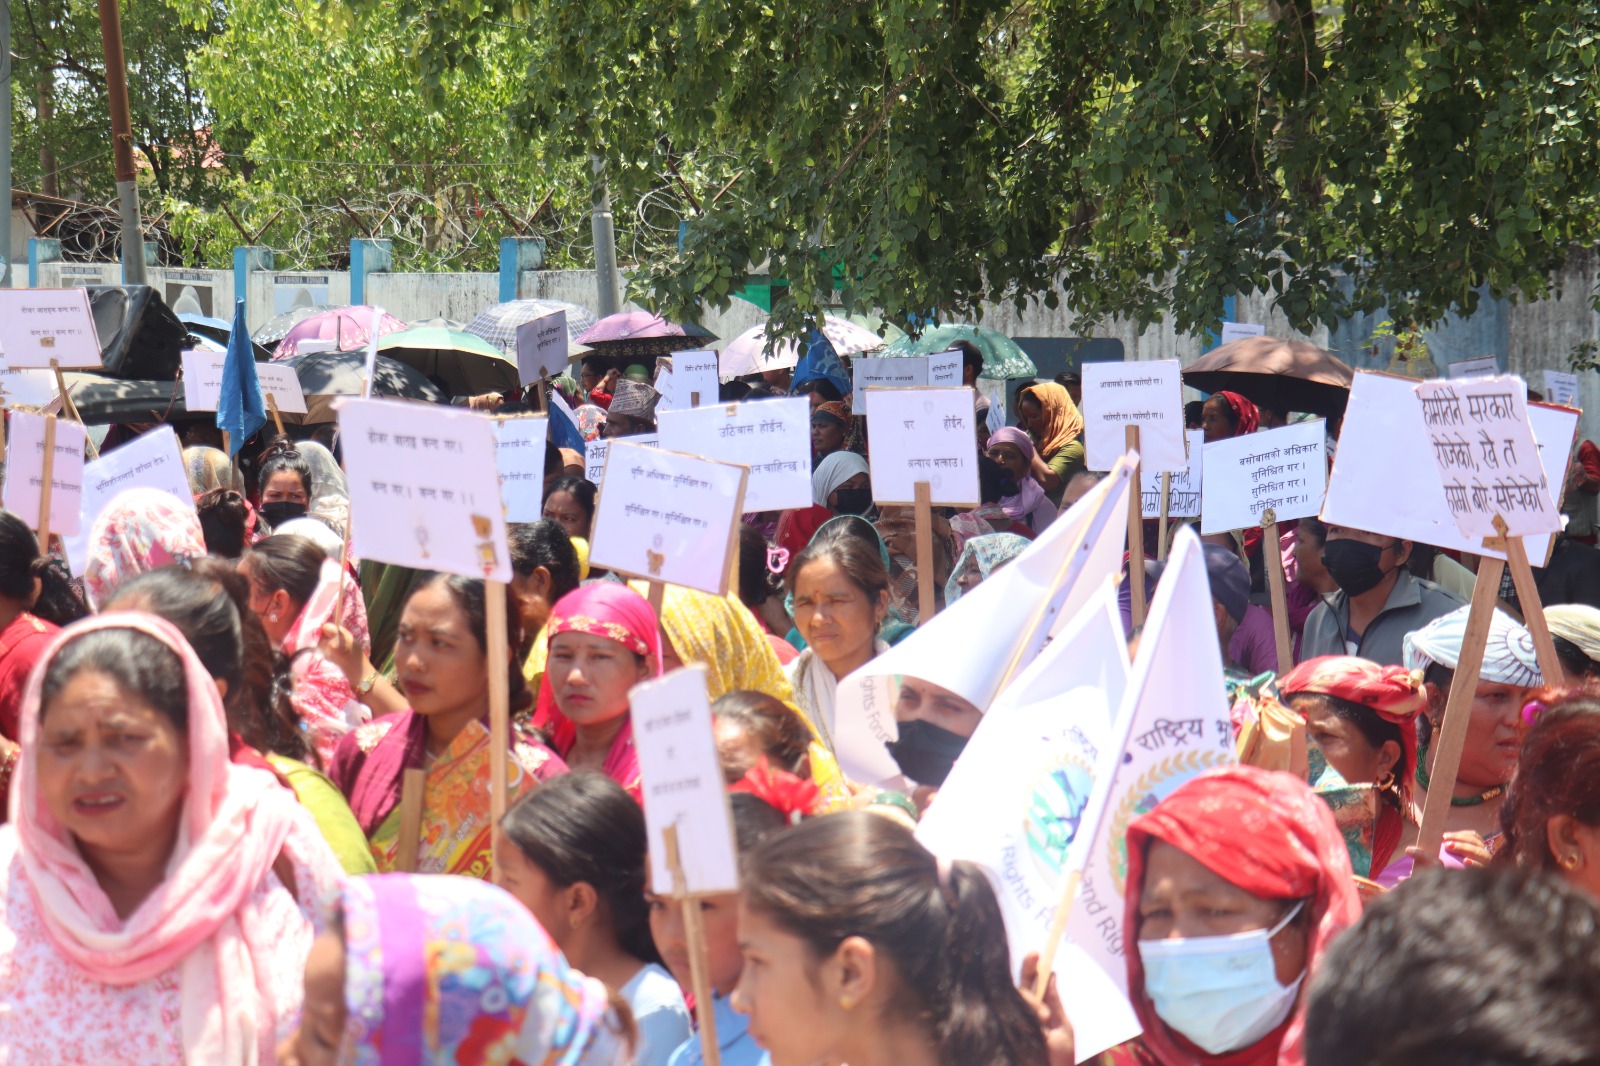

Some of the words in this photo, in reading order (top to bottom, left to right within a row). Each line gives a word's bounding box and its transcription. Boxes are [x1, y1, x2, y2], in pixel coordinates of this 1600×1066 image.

[1467, 393, 1520, 424] सरकार
[1284, 443, 1318, 456] अधिकार
[1504, 439, 1517, 468] त
[1251, 465, 1284, 483] सुनिश्चित
[1251, 481, 1285, 498] सुनिश्चित
[859, 675, 877, 711] ights
[1135, 718, 1203, 750] राष्ट्रिय
[1096, 916, 1125, 957] Rig
